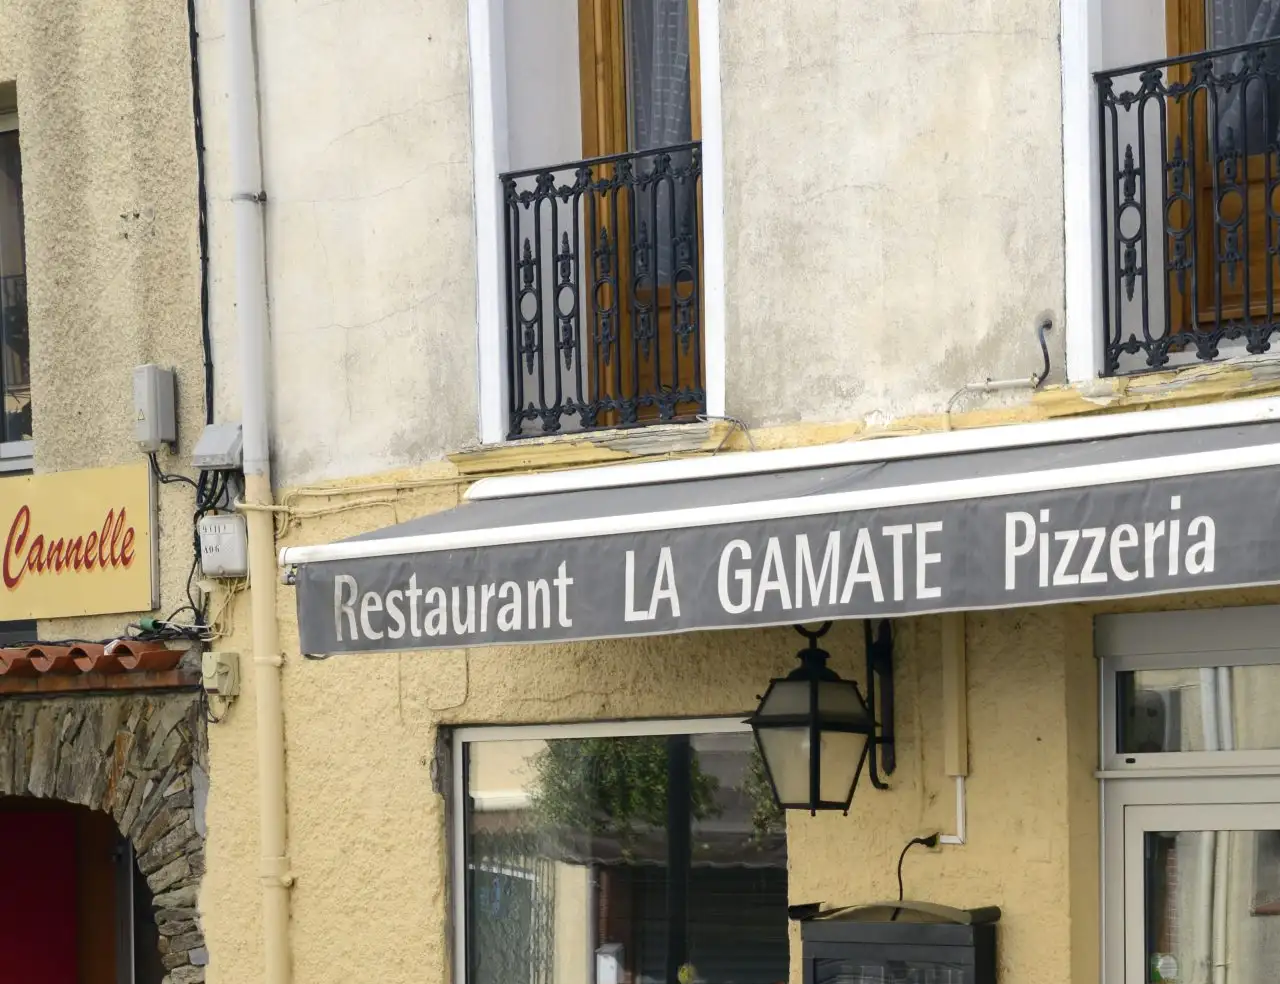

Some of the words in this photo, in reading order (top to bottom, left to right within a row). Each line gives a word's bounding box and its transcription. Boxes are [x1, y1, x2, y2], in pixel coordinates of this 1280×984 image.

[3, 505, 136, 590] Cannelle
[334, 560, 574, 641] Restaurant
[624, 546, 681, 622] LA
[718, 521, 943, 614] GAMATE
[1005, 495, 1215, 590] Pizzeria
